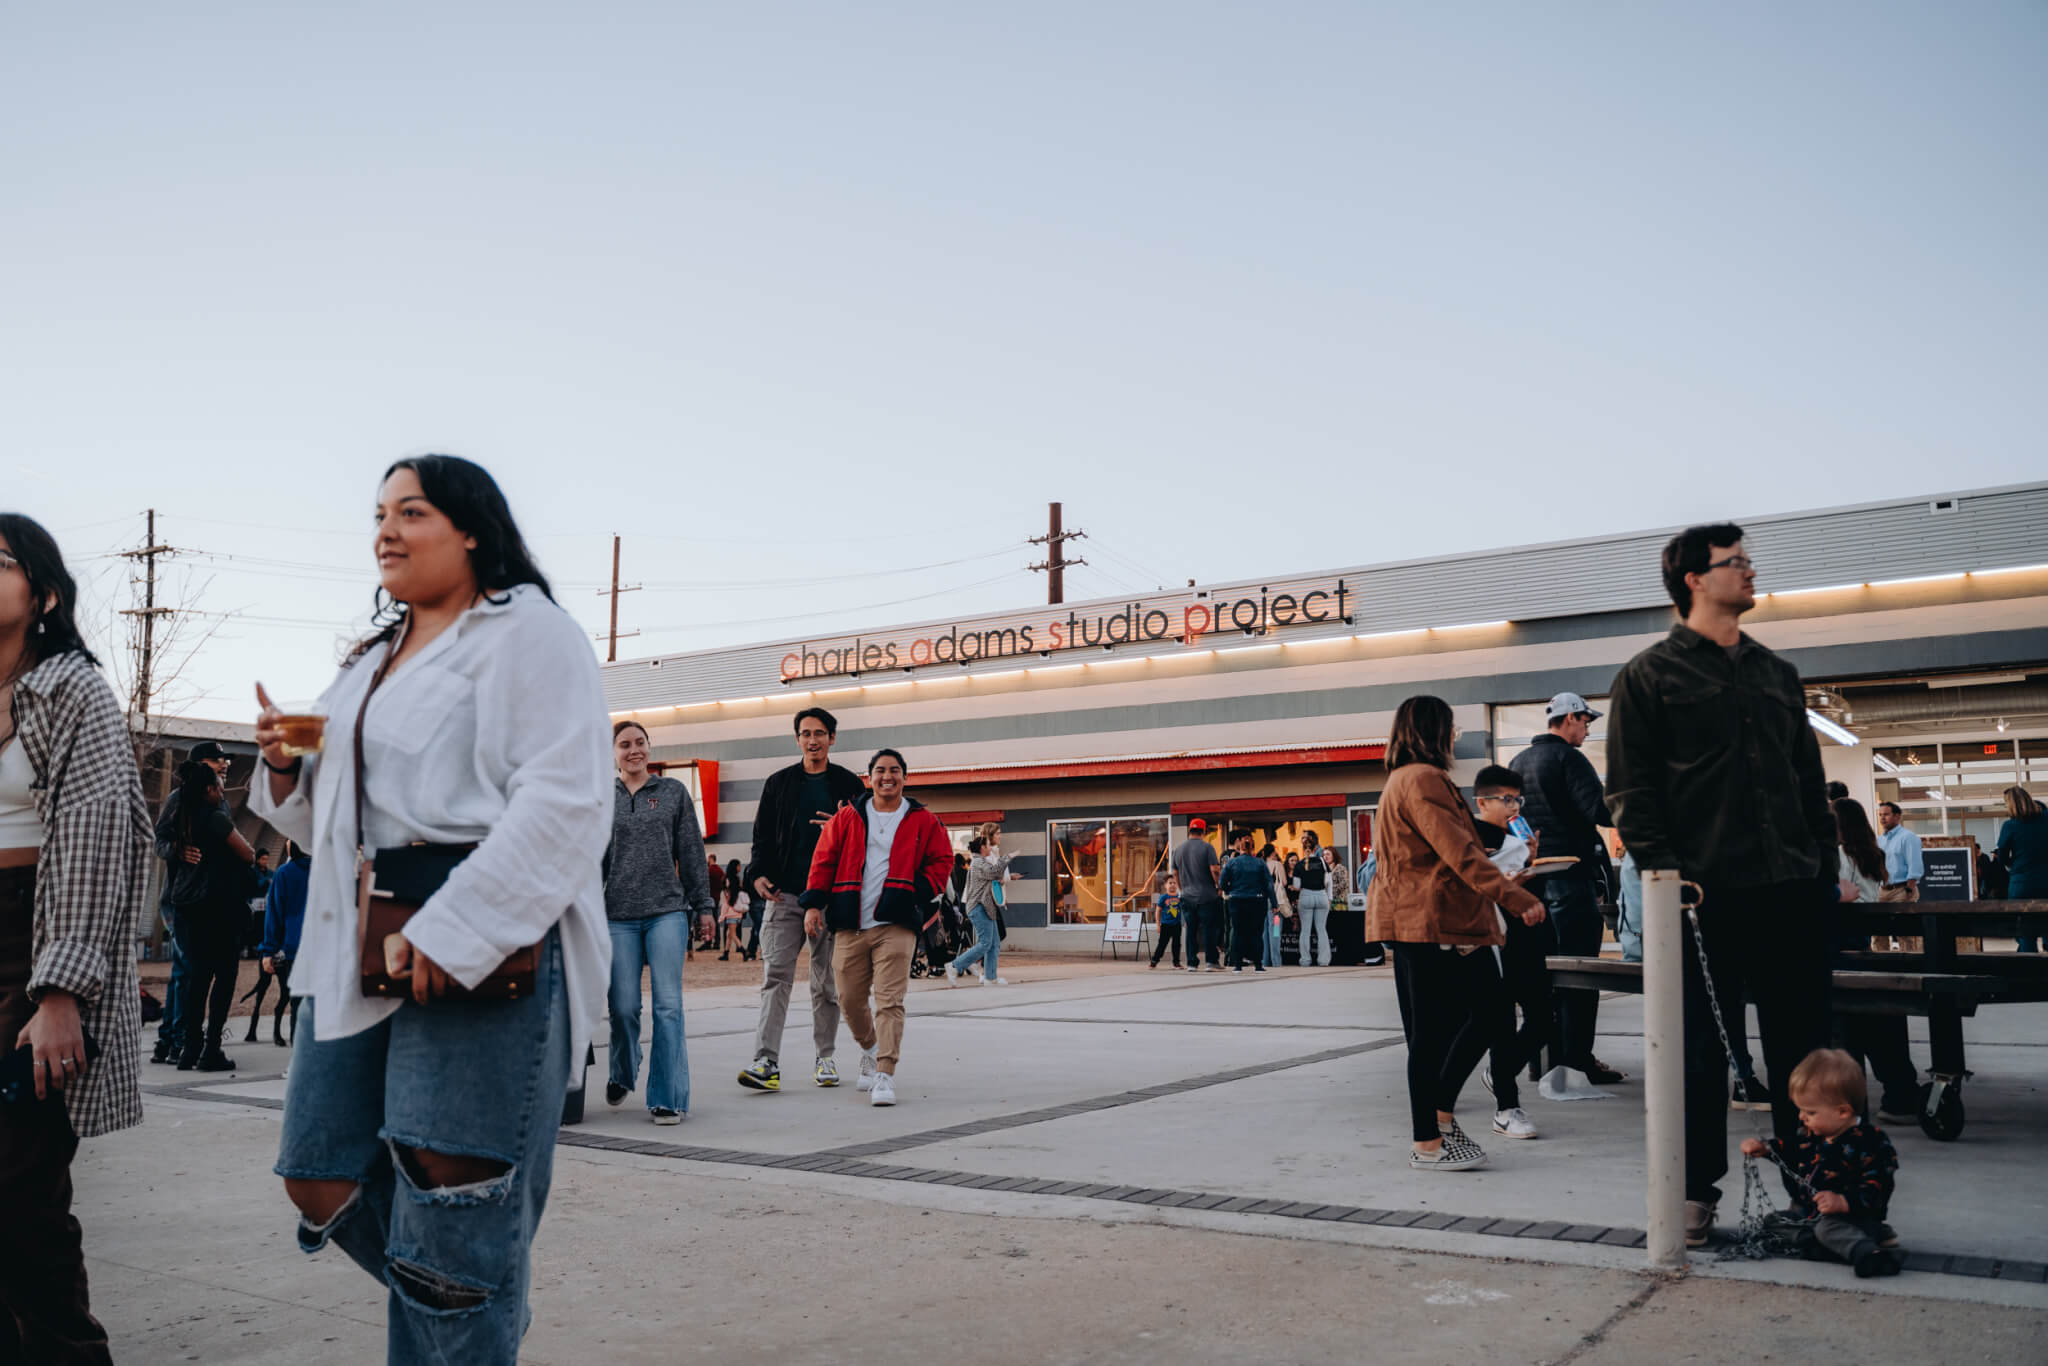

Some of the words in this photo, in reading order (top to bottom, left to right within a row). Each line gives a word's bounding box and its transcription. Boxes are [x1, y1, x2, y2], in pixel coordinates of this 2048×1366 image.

[781, 638, 897, 680] charles
[910, 626, 1034, 665] adams
[1048, 603, 1169, 649] studio
[1183, 580, 1350, 642] project
